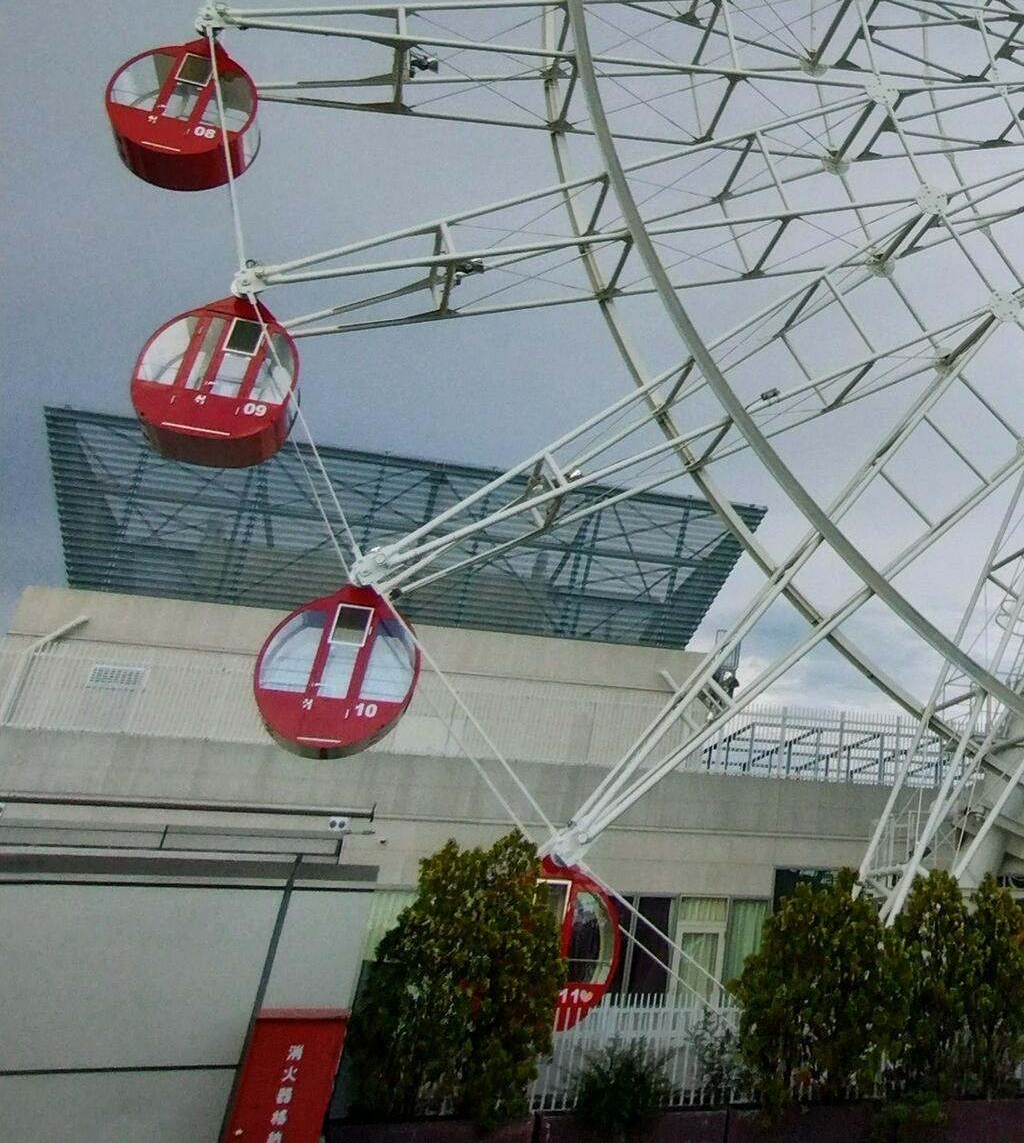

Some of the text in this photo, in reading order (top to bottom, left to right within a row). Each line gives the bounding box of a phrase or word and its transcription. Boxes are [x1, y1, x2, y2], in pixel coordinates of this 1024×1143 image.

[194, 126, 216, 139] 08
[243, 402, 268, 417] 09
[355, 702, 378, 718] 10
[559, 988, 580, 1004] 11
